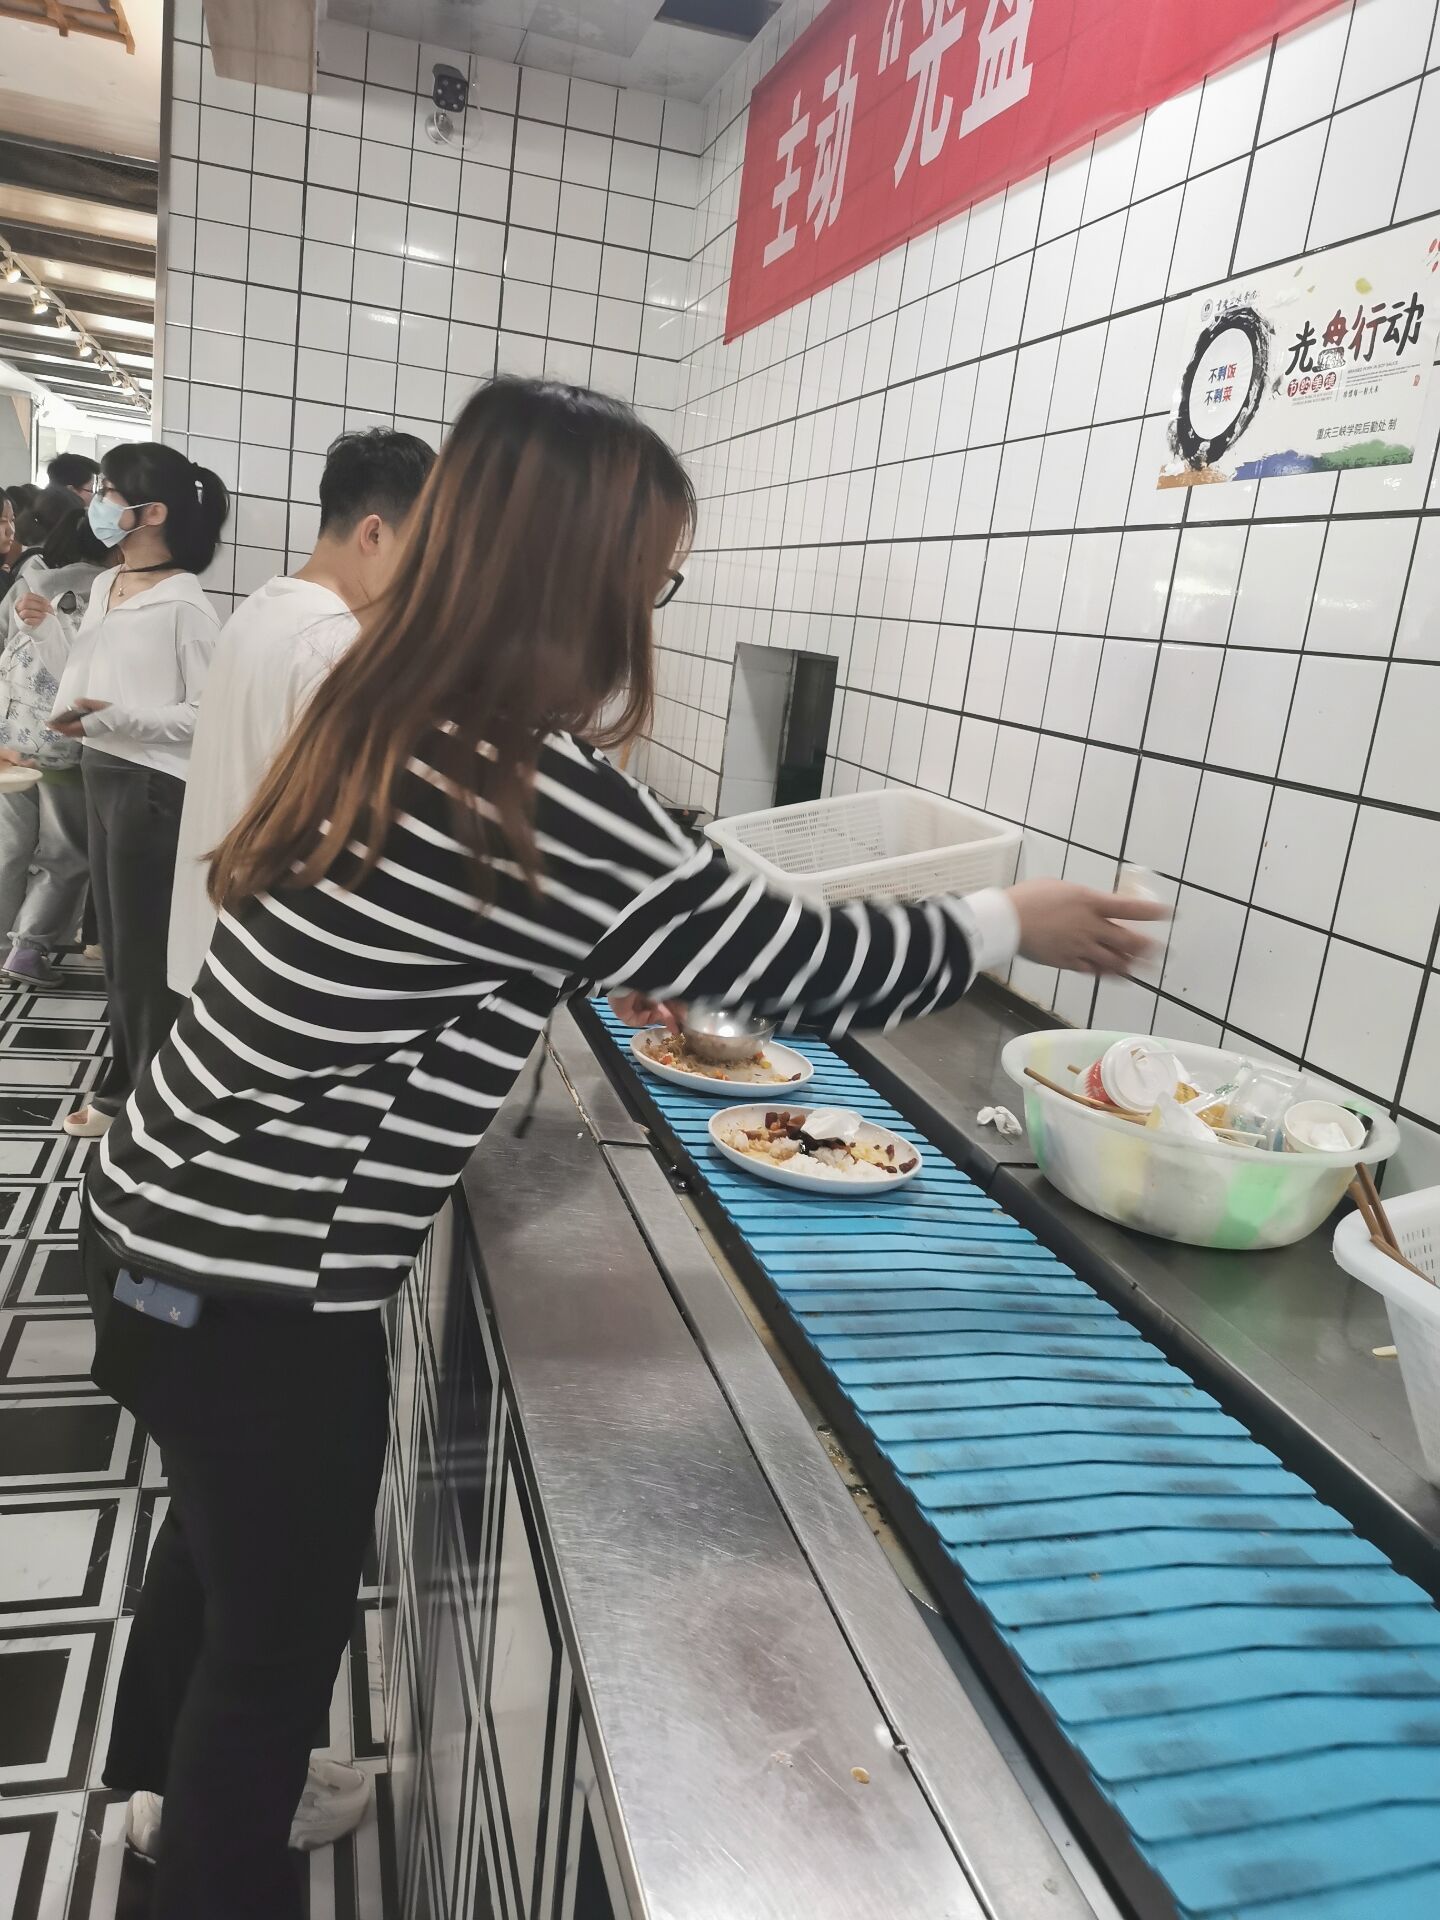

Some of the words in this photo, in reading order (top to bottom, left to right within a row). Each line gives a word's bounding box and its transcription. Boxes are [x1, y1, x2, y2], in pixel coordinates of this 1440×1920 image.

[1285, 292, 1425, 375] 光盘行动
[1208, 363, 1237, 383] 不剩饭
[1204, 386, 1233, 405] 不剩菜
